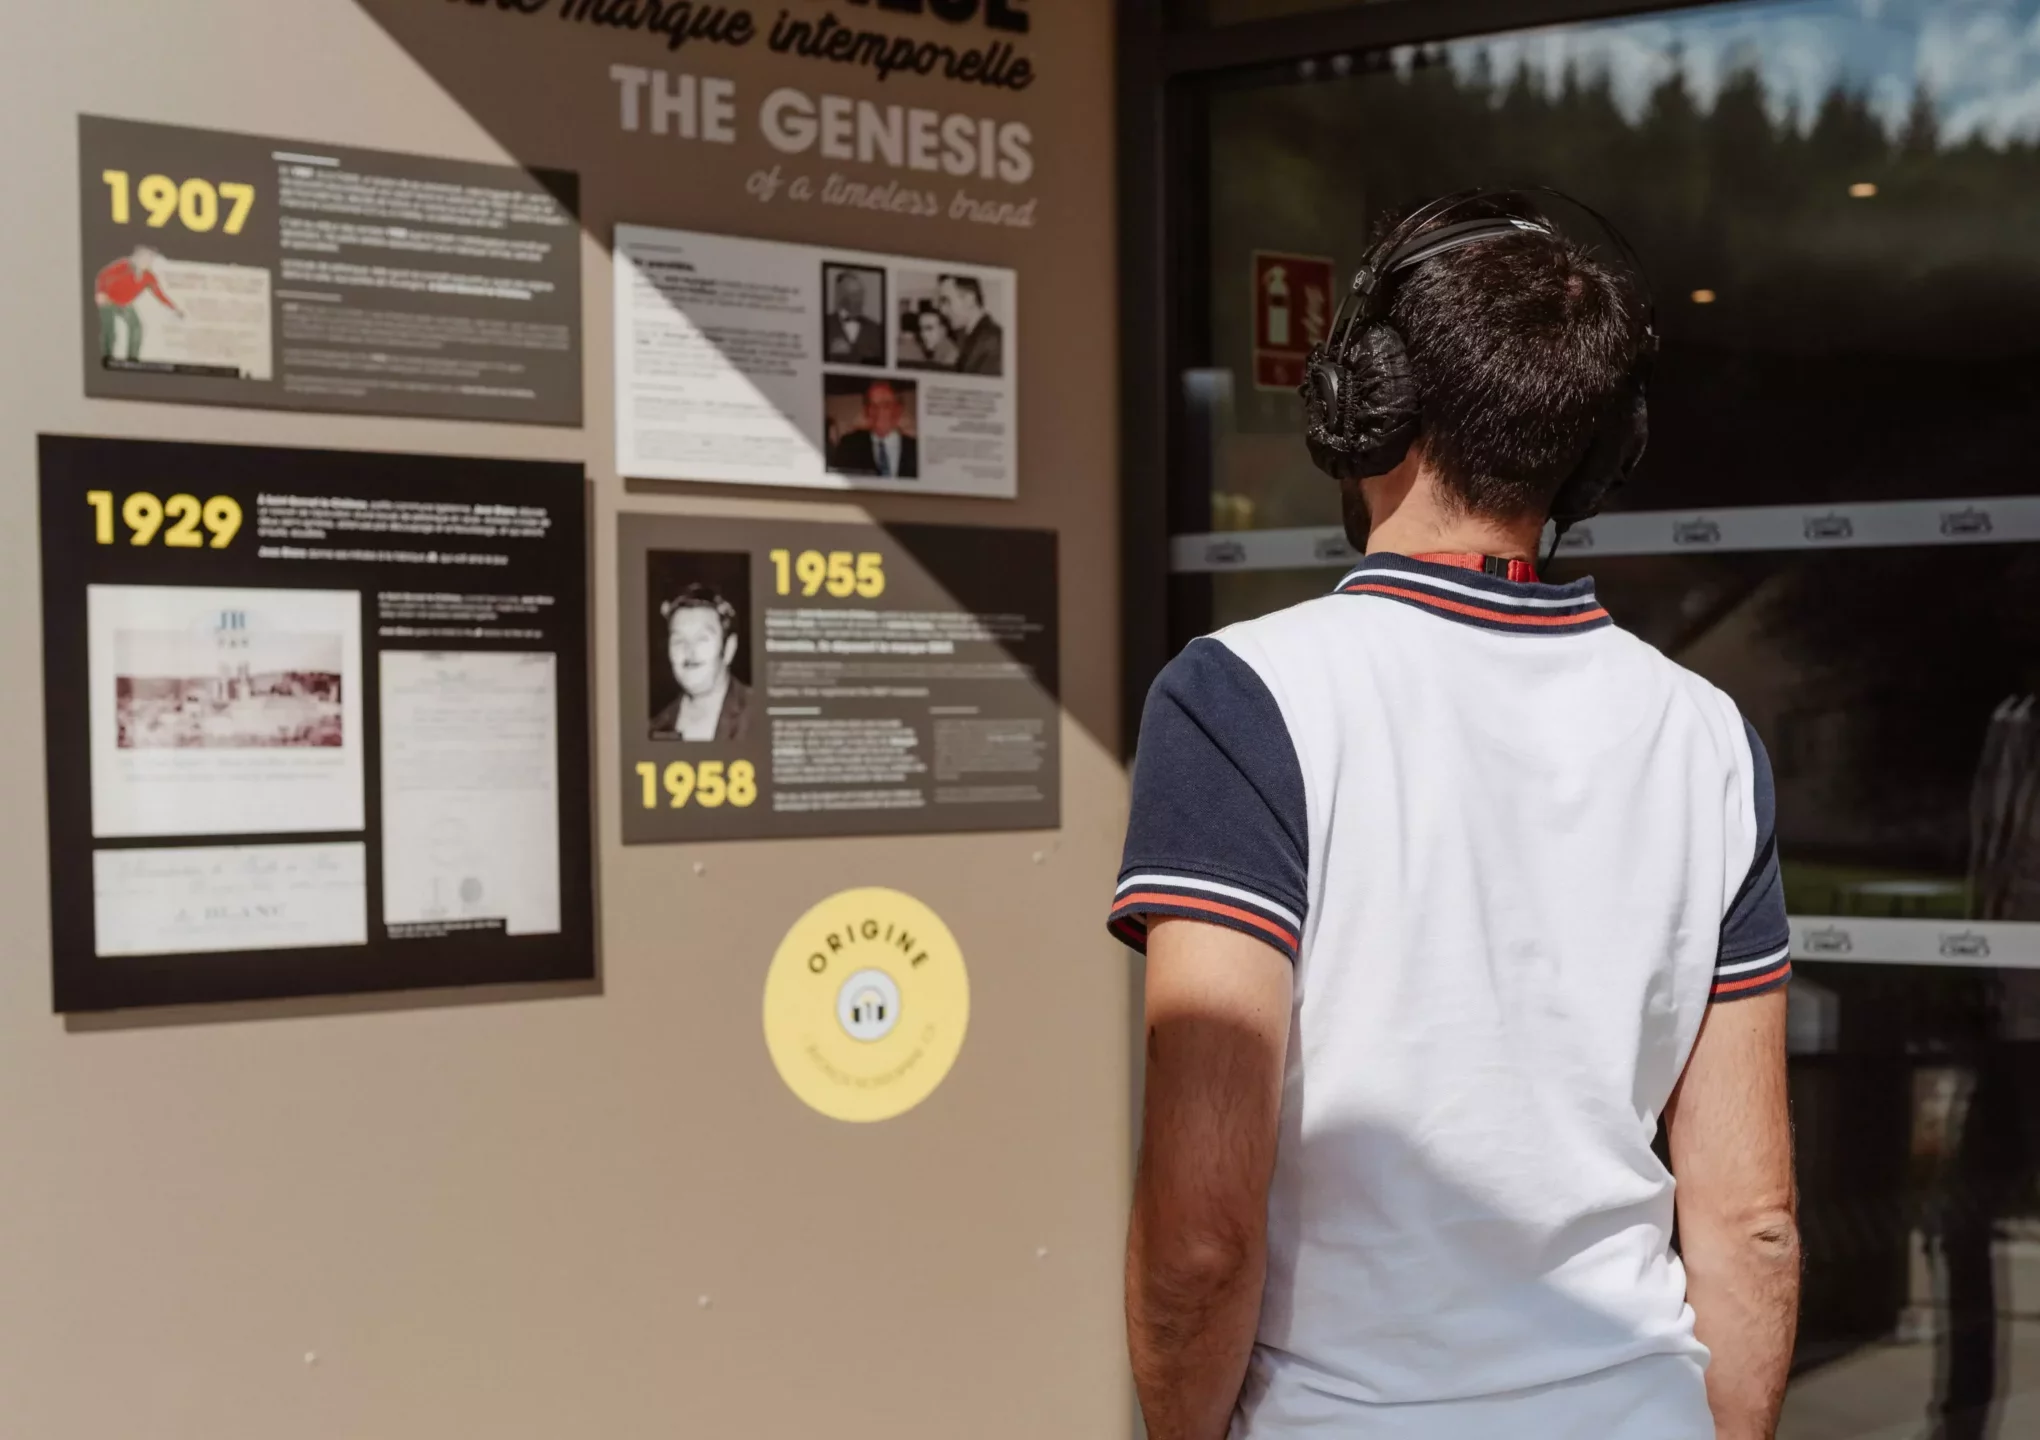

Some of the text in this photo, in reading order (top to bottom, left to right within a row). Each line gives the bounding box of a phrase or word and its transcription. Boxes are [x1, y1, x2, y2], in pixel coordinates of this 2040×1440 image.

[558, 0, 755, 51] marque
[768, 9, 1036, 91] intemporelle
[610, 65, 1034, 184] THE GENESIS
[101, 168, 256, 236] 1907
[745, 164, 1038, 228] of a timeless brand
[86, 489, 244, 549] 1929
[769, 548, 887, 599] 1955
[634, 758, 758, 809] 1958
[806, 918, 931, 975] ORIGINE
